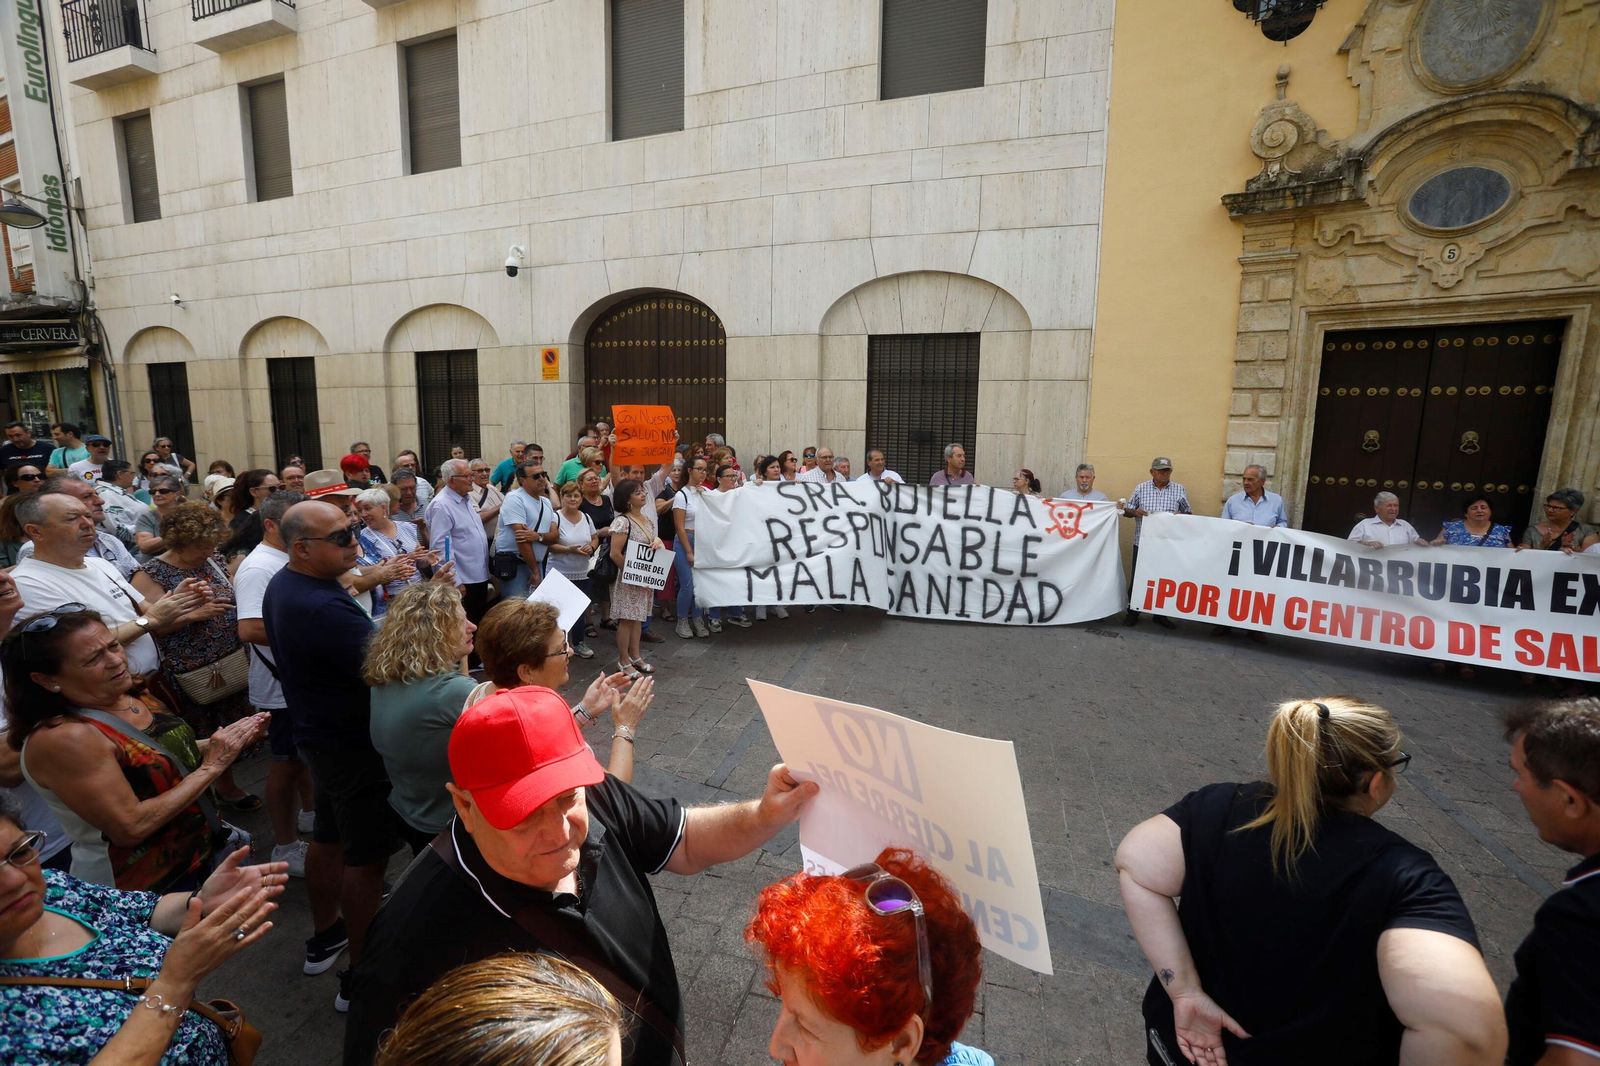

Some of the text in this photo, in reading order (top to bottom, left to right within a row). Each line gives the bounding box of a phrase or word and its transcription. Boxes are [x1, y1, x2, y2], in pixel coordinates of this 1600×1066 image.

[43, 174, 69, 253] idiomas
[1447, 248, 1456, 260] 5
[21, 327, 78, 340] CERVERA
[619, 428, 659, 442] SALUD
[777, 480, 1037, 529] SRA. BOTELLA
[638, 545, 654, 561] NO
[765, 512, 1042, 577] RESPONSABLE
[624, 572, 642, 582] CENTRO
[627, 560, 664, 575] AL CIERRE DEL
[745, 555, 870, 602] MALA
[1252, 539, 1535, 611] VILLARRUBIA
[1143, 578, 1600, 673] ¡POR UN CENTRO DE SAL
